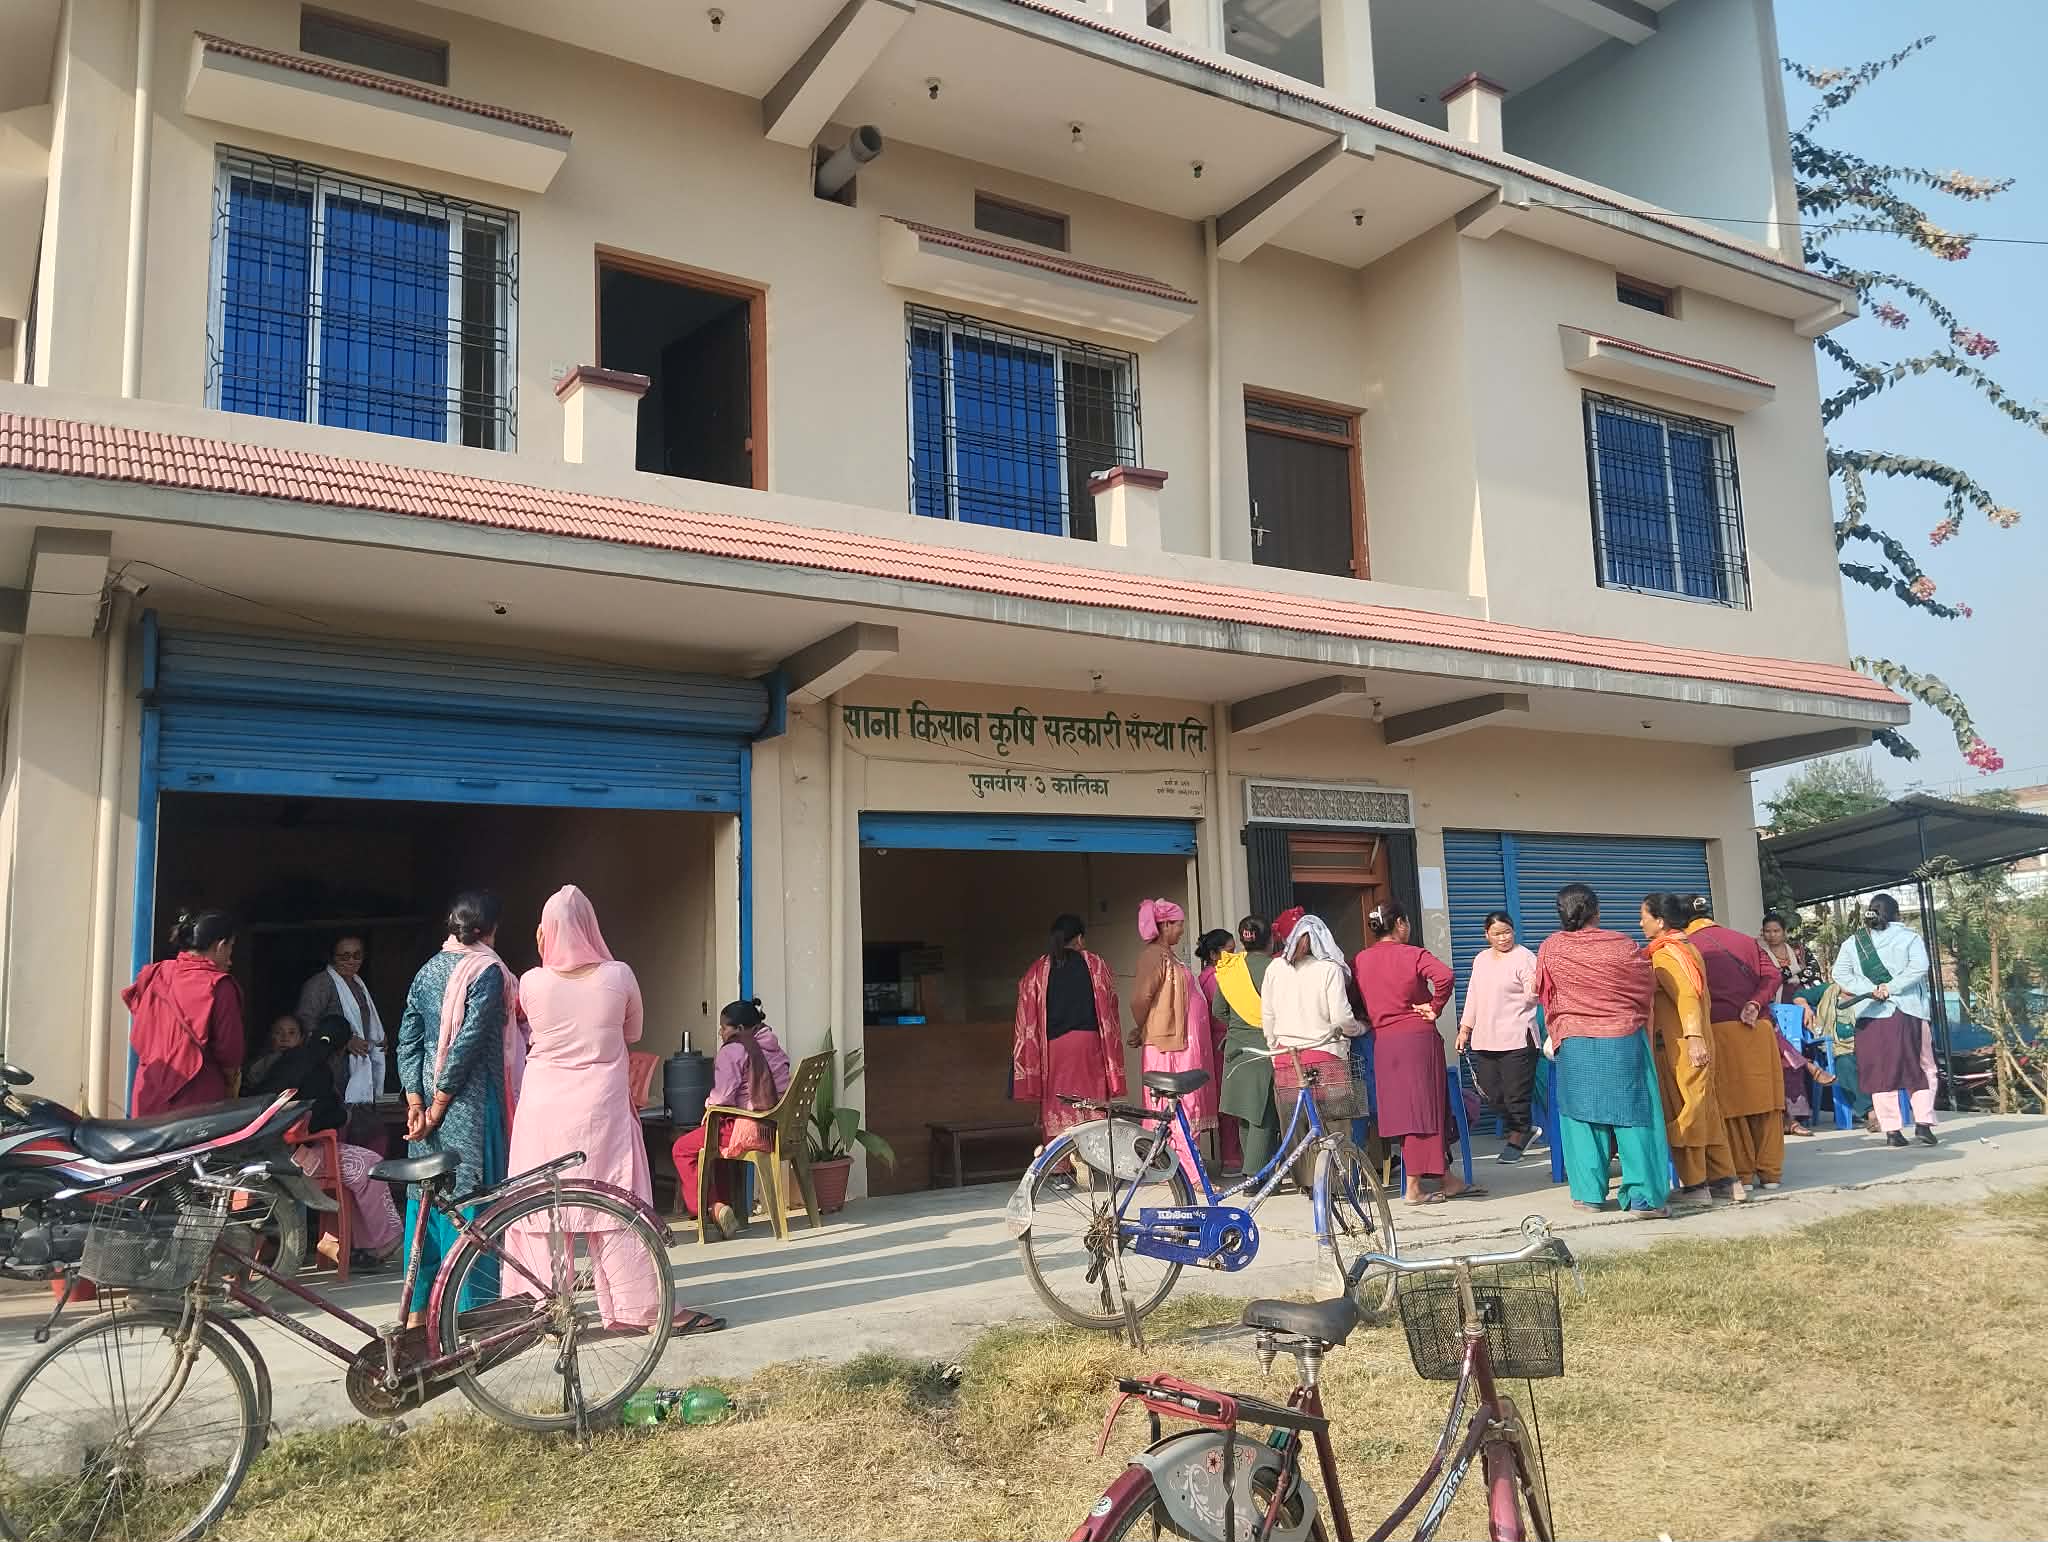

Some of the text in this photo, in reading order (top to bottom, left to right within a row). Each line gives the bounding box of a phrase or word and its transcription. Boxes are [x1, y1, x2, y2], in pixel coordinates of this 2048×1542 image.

[843, 705, 900, 739] साना
[905, 700, 982, 745] किसान
[987, 706, 1038, 757] कृषि
[1042, 711, 1122, 755] सहकारी
[1051, 774, 1109, 796] कालिका
